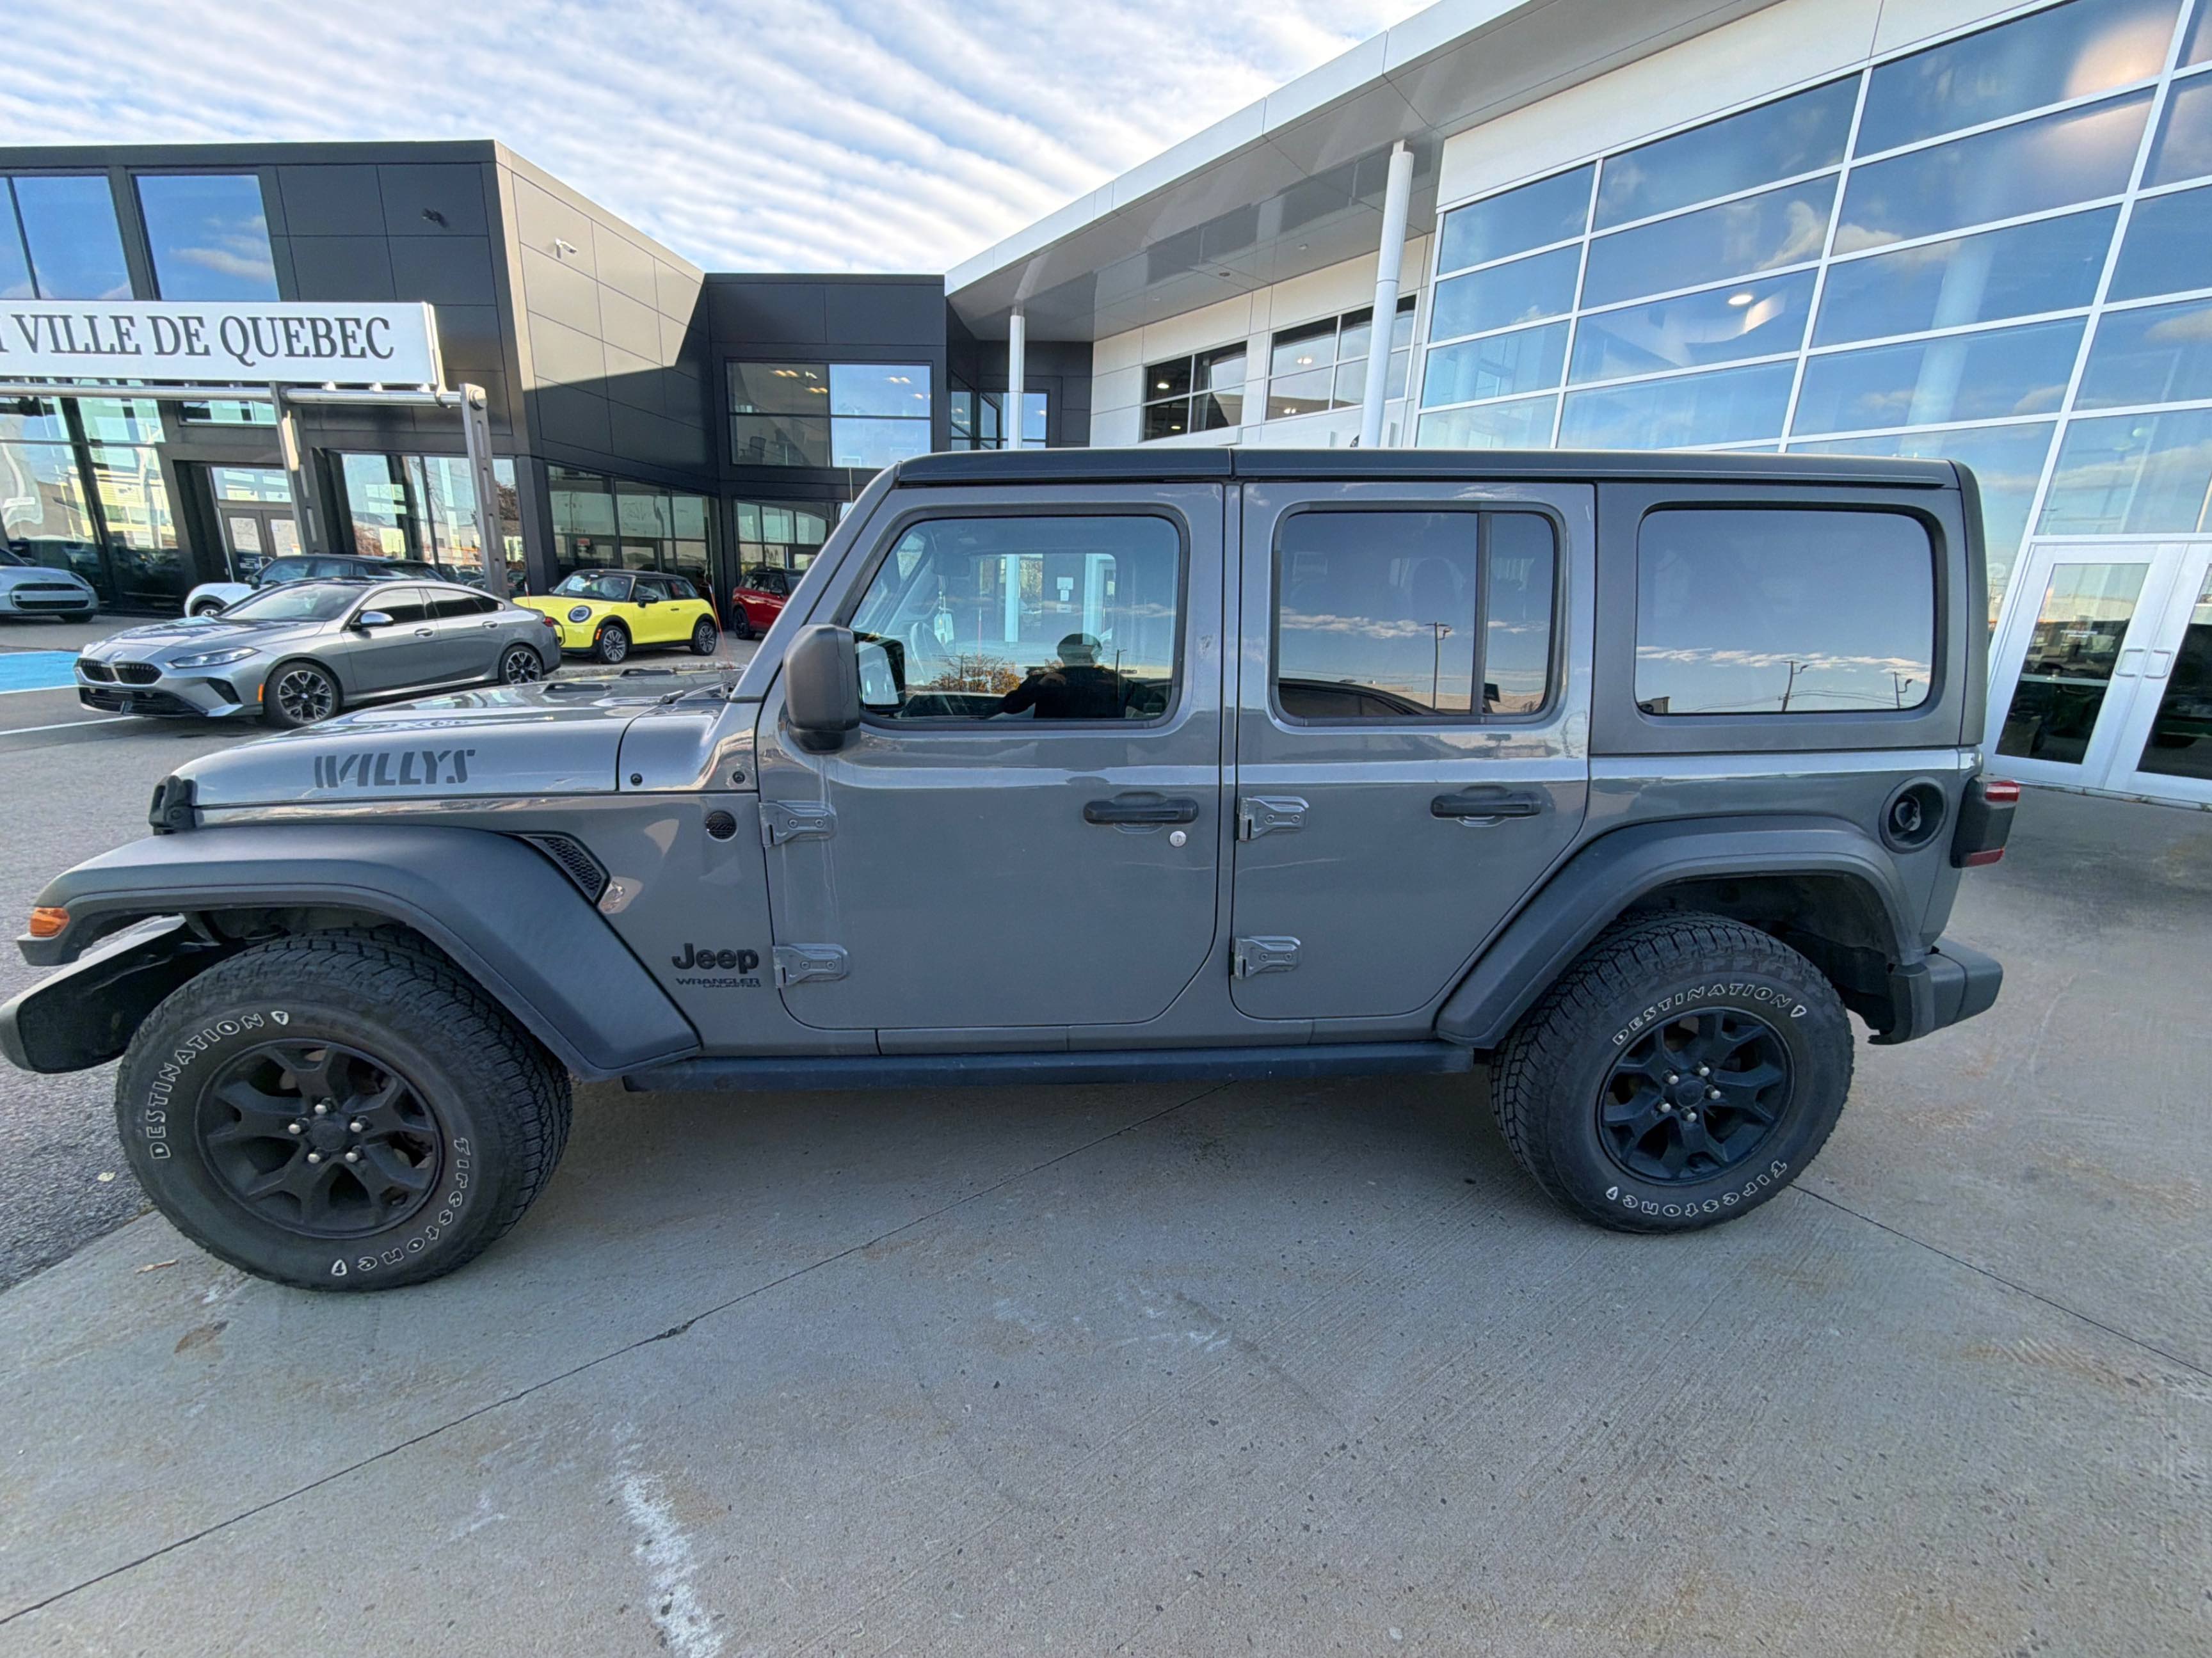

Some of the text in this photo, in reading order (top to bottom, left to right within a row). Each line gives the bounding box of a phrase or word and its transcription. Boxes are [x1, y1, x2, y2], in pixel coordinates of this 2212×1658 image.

[10, 314, 394, 367] VILLE DE QUEBEC
[314, 749, 476, 788] WILLYS
[671, 943, 759, 974] Jeep
[1612, 983, 1791, 1046] DESTINATION
[146, 1013, 265, 1160] DESTINATION
